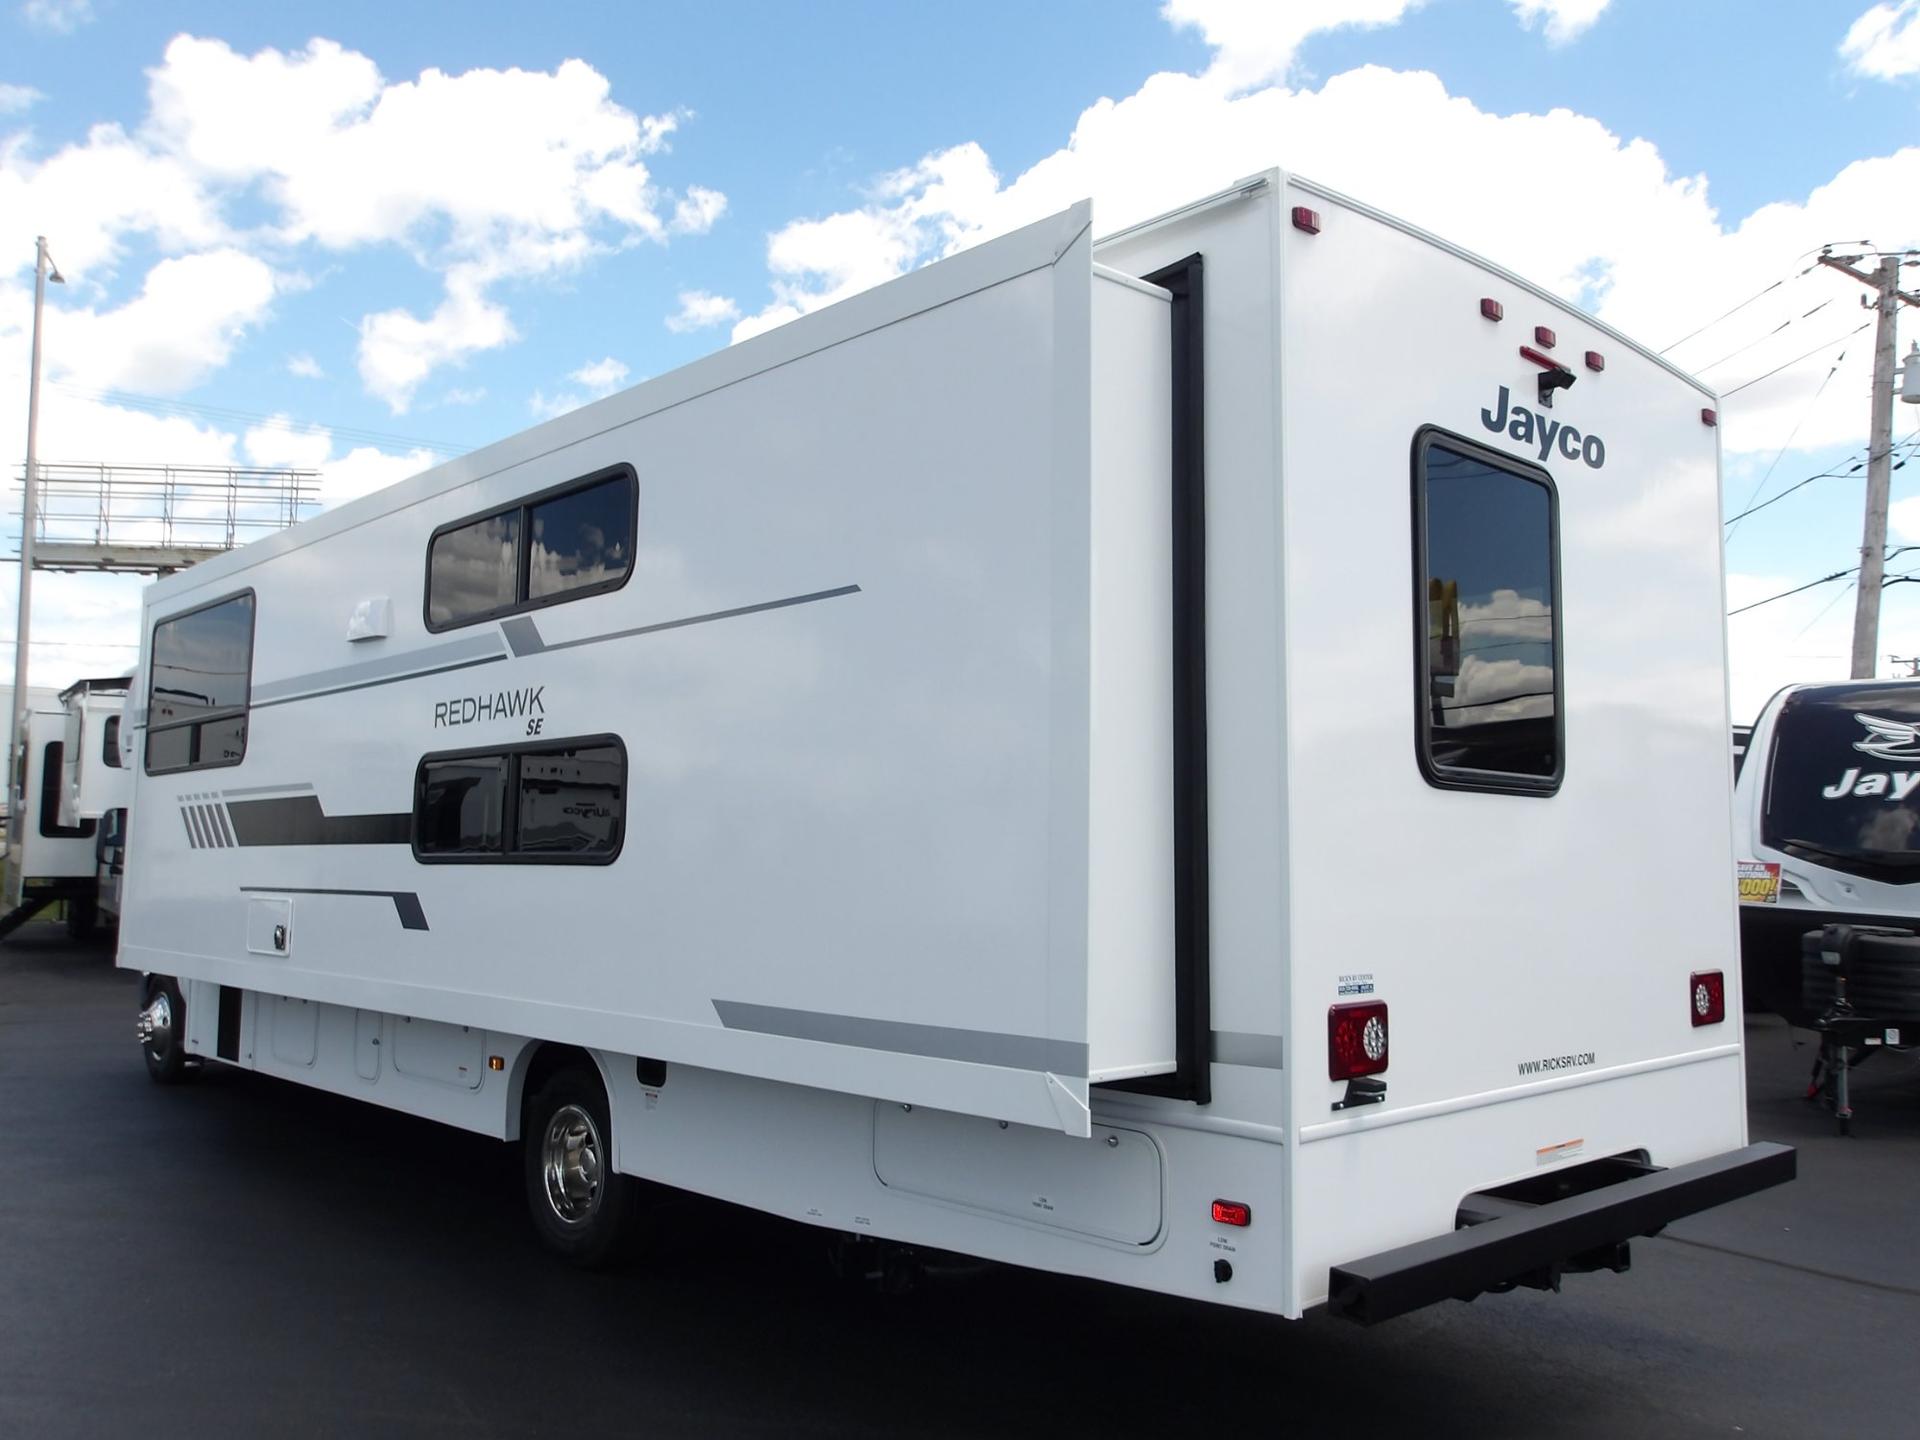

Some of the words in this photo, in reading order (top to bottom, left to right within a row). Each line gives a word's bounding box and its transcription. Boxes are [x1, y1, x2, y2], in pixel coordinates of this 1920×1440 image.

[1481, 385, 1605, 469] Jayco
[434, 686, 545, 728] REDHAWK
[526, 718, 544, 736] SE
[1517, 1052, 1595, 1076] WWW.RICKSRV.COM
